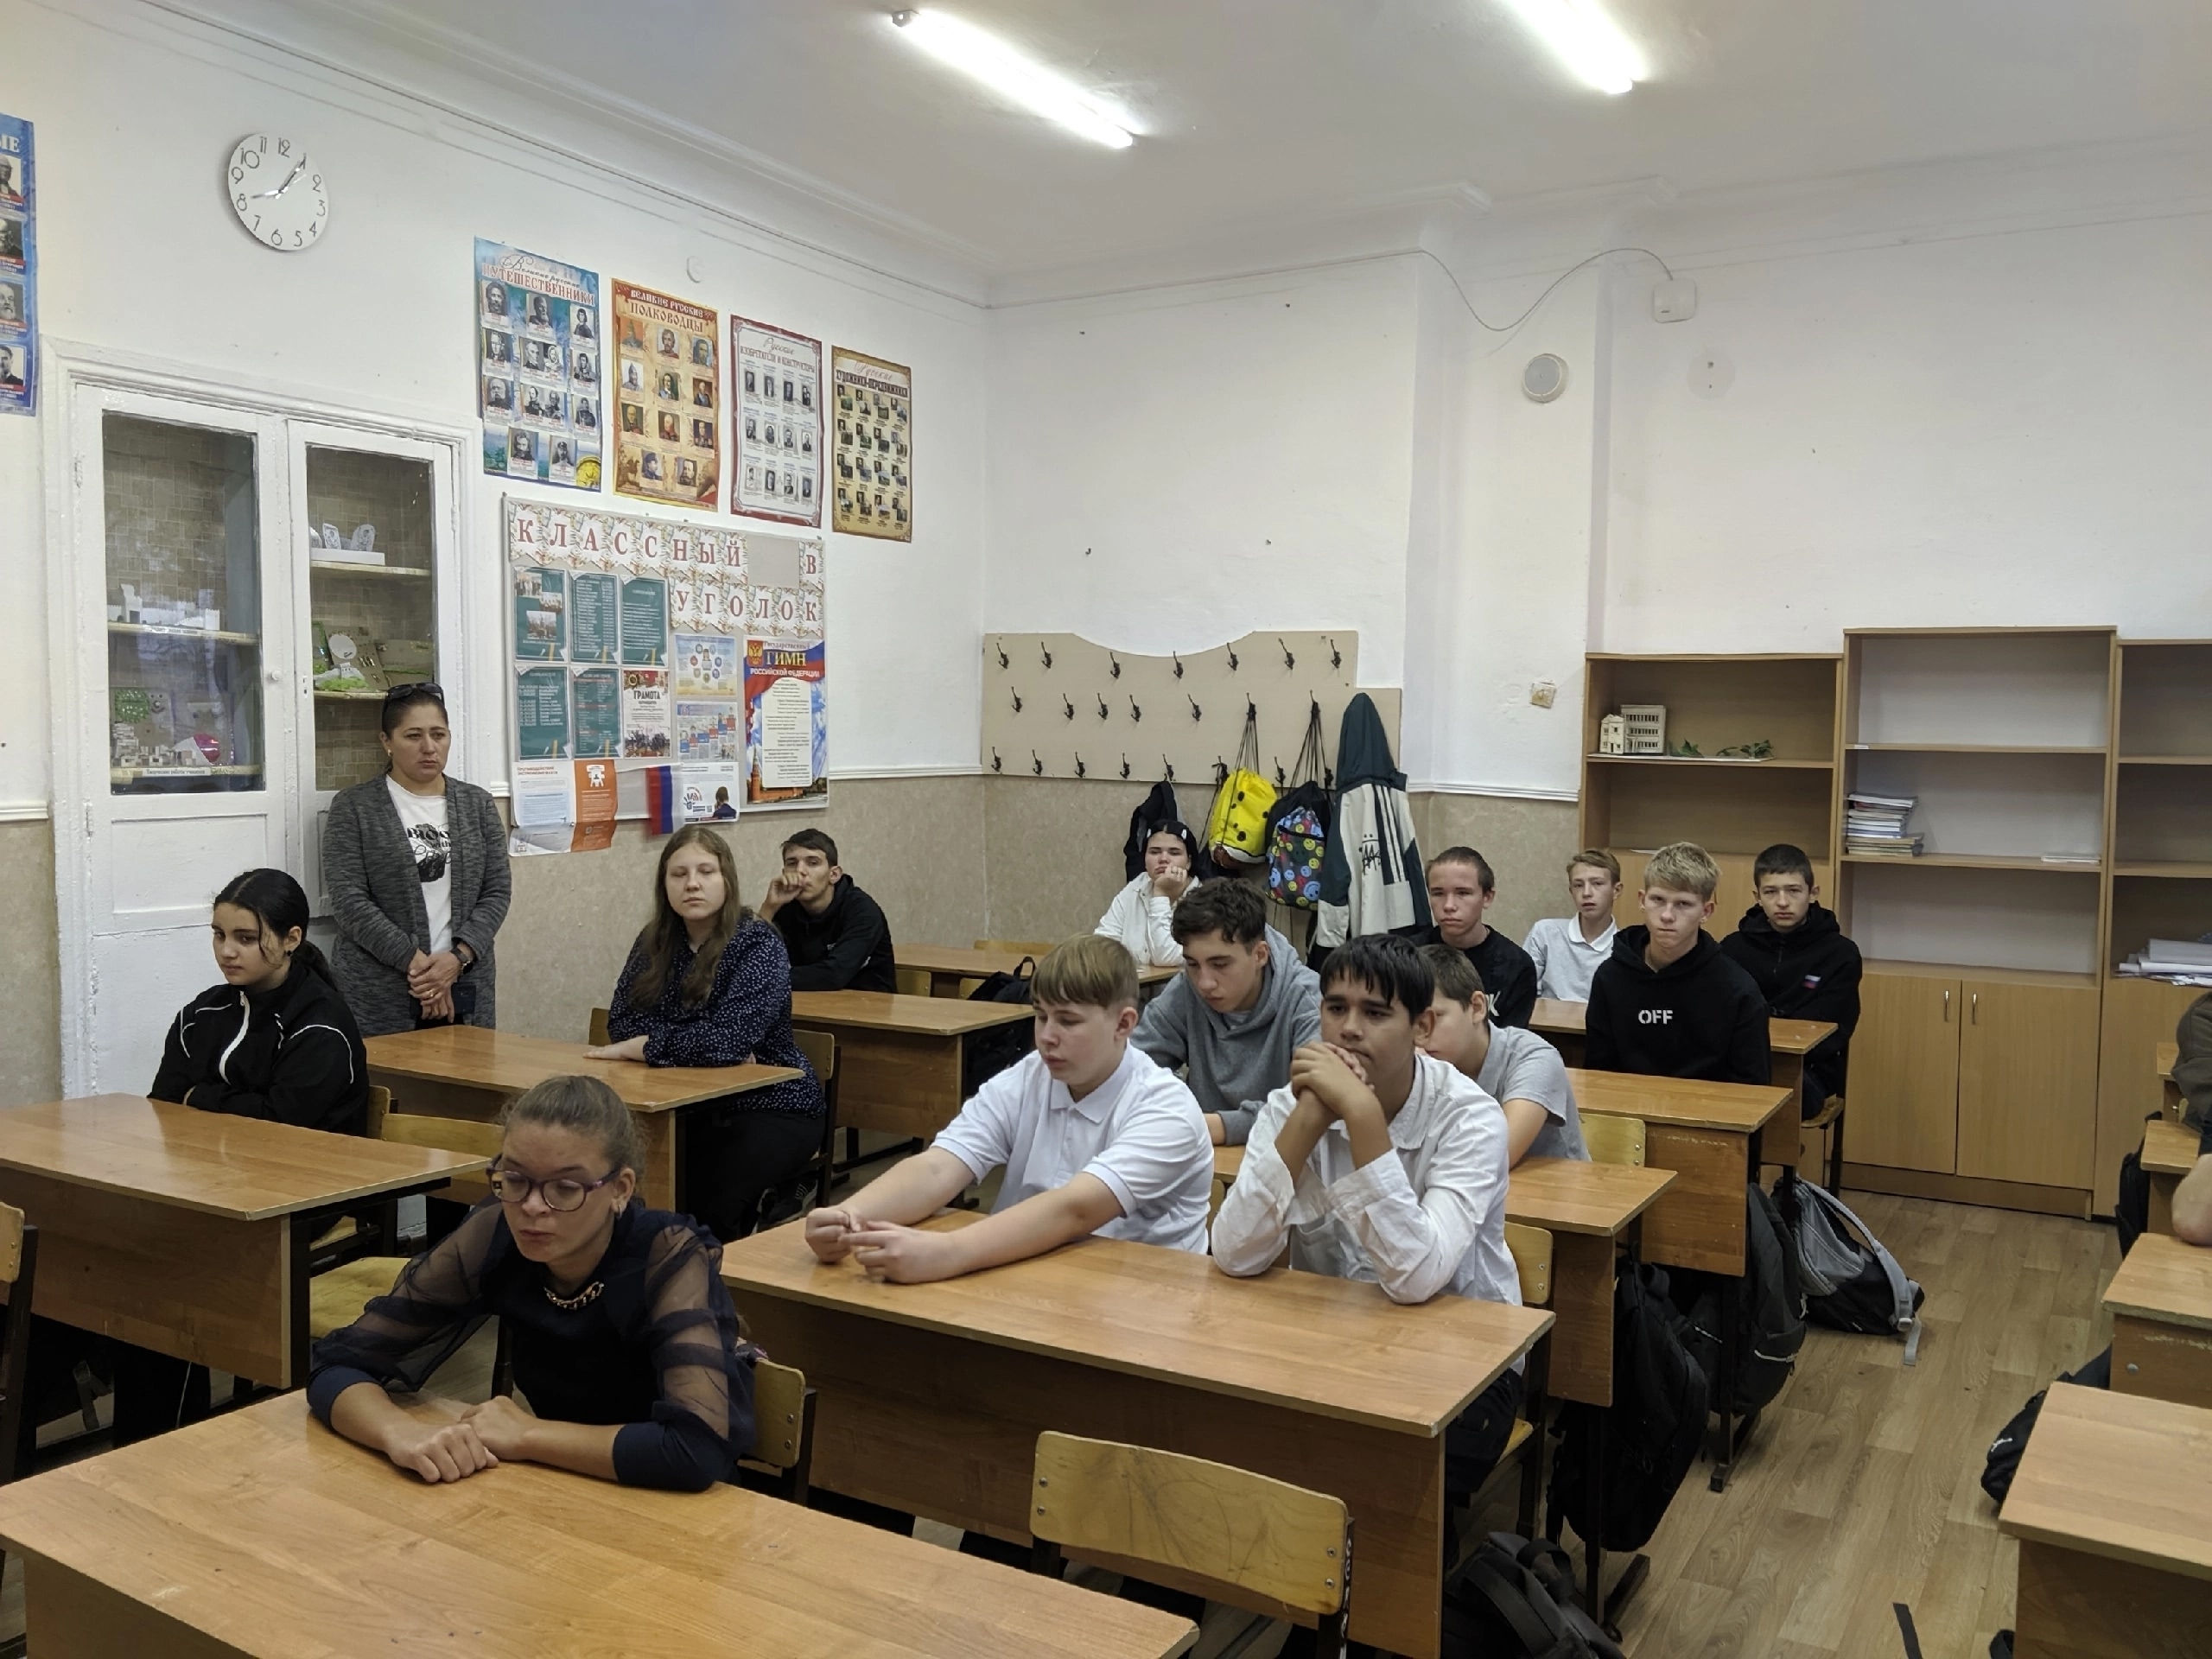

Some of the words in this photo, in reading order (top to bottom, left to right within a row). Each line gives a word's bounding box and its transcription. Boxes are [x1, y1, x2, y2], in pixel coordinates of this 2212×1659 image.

[260, 137, 267, 154] 11
[277, 137, 290, 158] 12
[240, 147, 260, 168] 10
[231, 167, 244, 184] 9
[312, 175, 321, 193] 2
[236, 194, 247, 211] 8
[316, 200, 326, 217] 3
[253, 214, 261, 231] 7
[309, 221, 317, 237] 4
[271, 229, 283, 245] 6
[294, 231, 302, 246] 5
[482, 264, 596, 306] ПУТЕШЕСТВЕННИКИ
[631, 289, 669, 307] ВЕЛИКИЕ
[670, 301, 703, 318] РУССКИЕ
[631, 302, 703, 333] ПОЛКОВОДЦЫ
[517, 518, 741, 568] КЛАССНЫЙ
[677, 590, 817, 622] УГОЛОК
[766, 652, 807, 666] ГИМН
[750, 668, 787, 677] РОССИЙСКОЙ
[633, 690, 661, 700] ГРАМОТА
[1638, 1009, 1673, 1025] OFF
